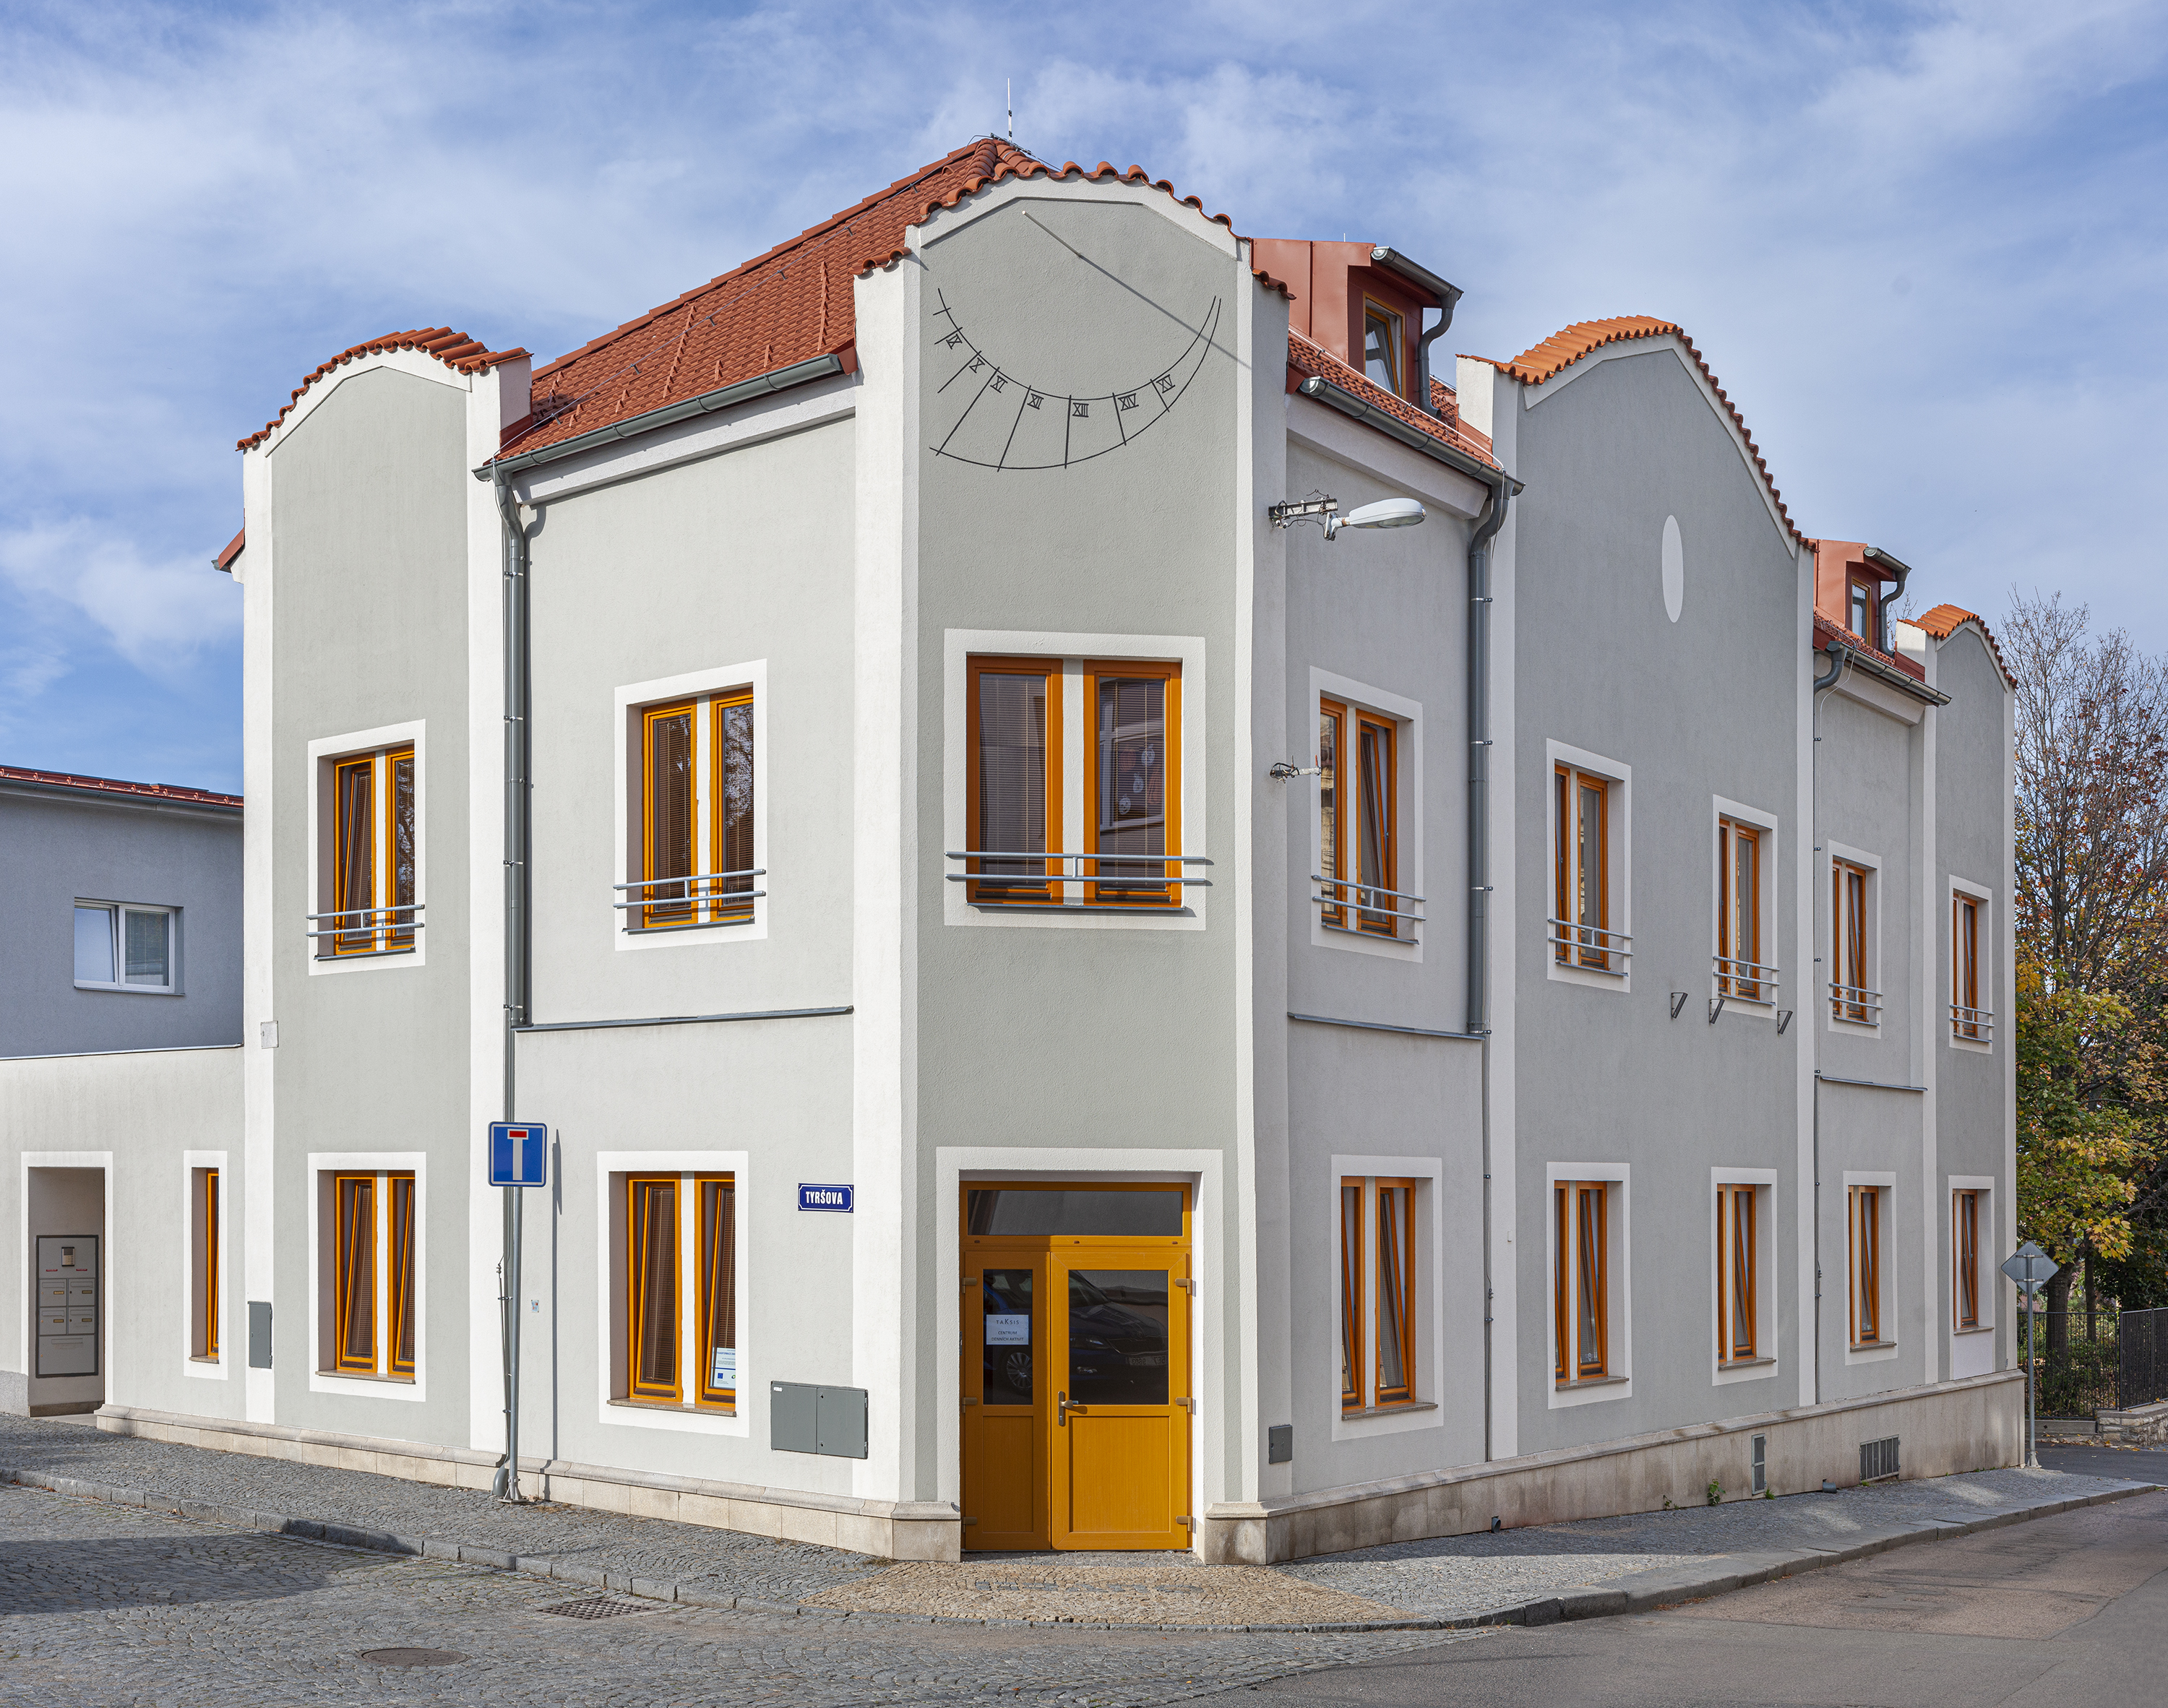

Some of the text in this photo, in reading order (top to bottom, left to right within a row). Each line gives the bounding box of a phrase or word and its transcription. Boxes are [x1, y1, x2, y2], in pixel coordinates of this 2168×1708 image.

[969, 357, 986, 374] X
[990, 375, 1008, 394] XI
[1156, 374, 1176, 394] XV
[1027, 393, 1044, 410] XII
[1072, 402, 1089, 418] XIII
[1117, 392, 1139, 411] XIV
[805, 1189, 843, 1205] TYRŠOVA
